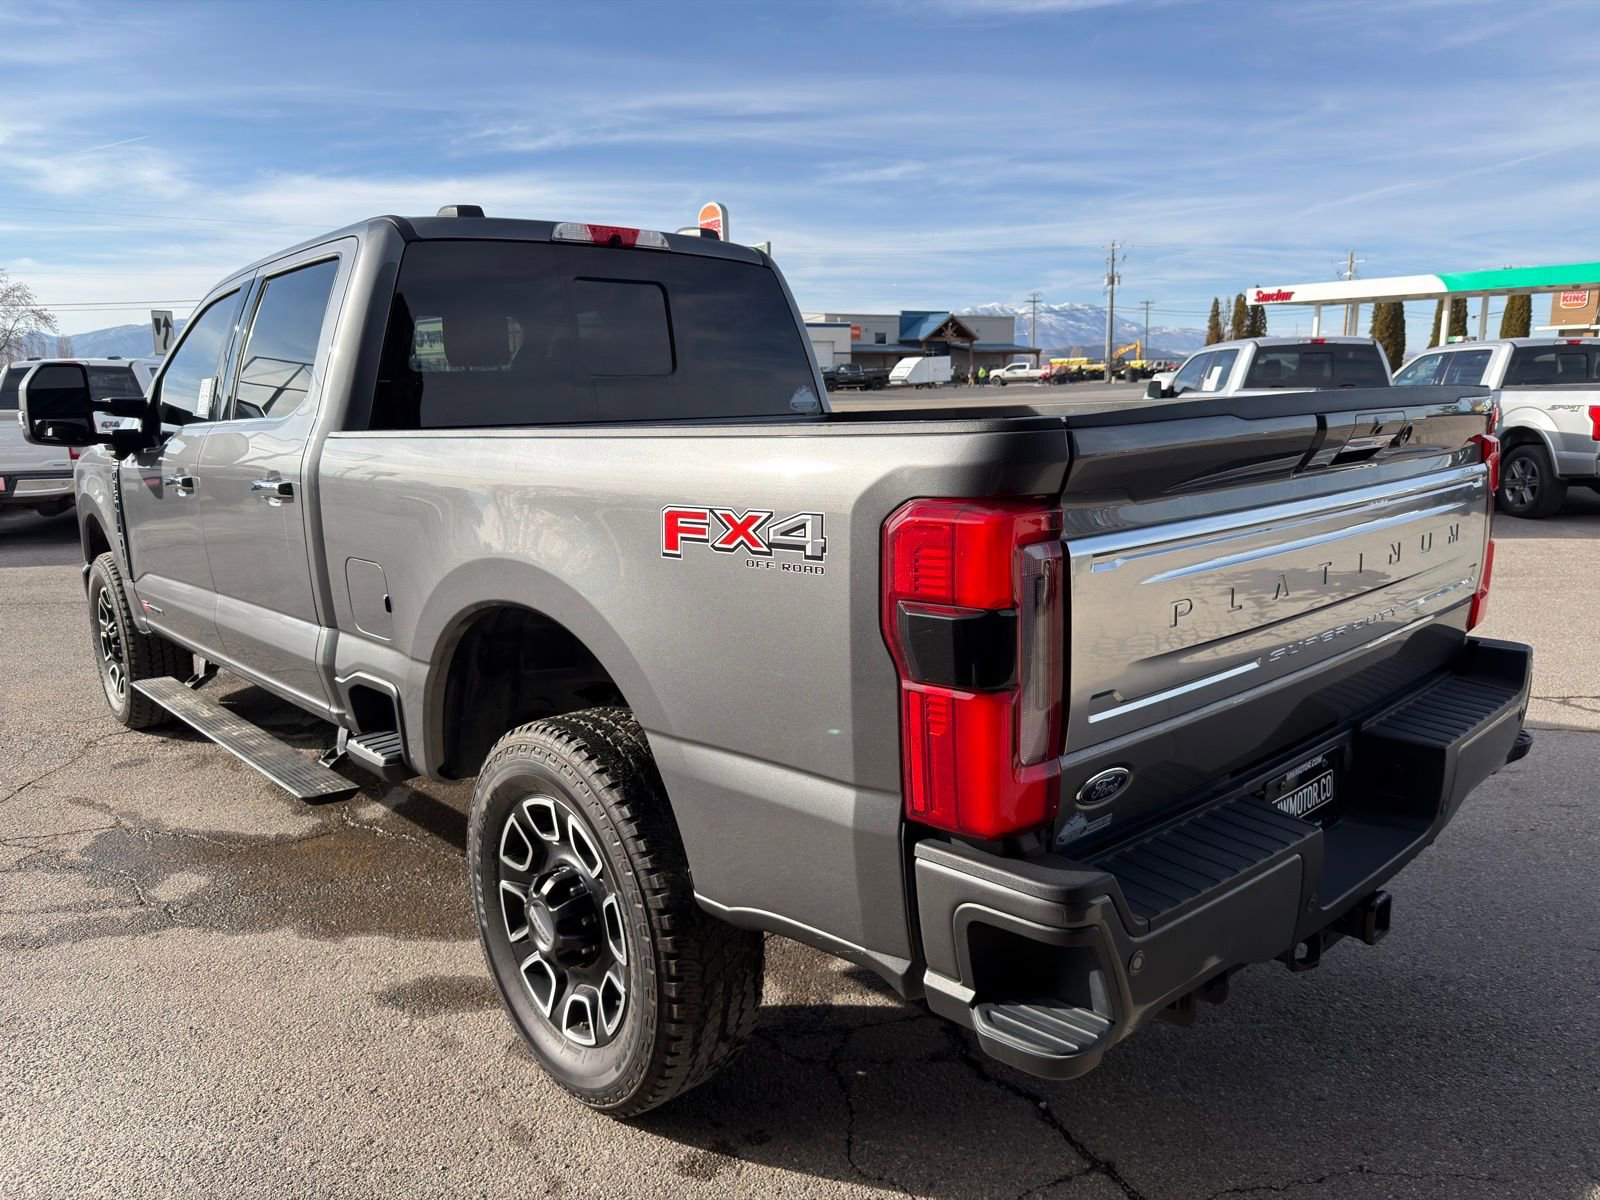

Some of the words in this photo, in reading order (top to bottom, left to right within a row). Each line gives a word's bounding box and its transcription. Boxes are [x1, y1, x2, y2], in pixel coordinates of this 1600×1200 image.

[661, 504, 827, 562] FX4
[746, 559, 775, 569] OFF
[782, 563, 825, 575] ROAD
[1169, 523, 1460, 628] PLATINUM
[1091, 775, 1122, 799] Ford
[1277, 775, 1332, 817] WMOTOR.CO
